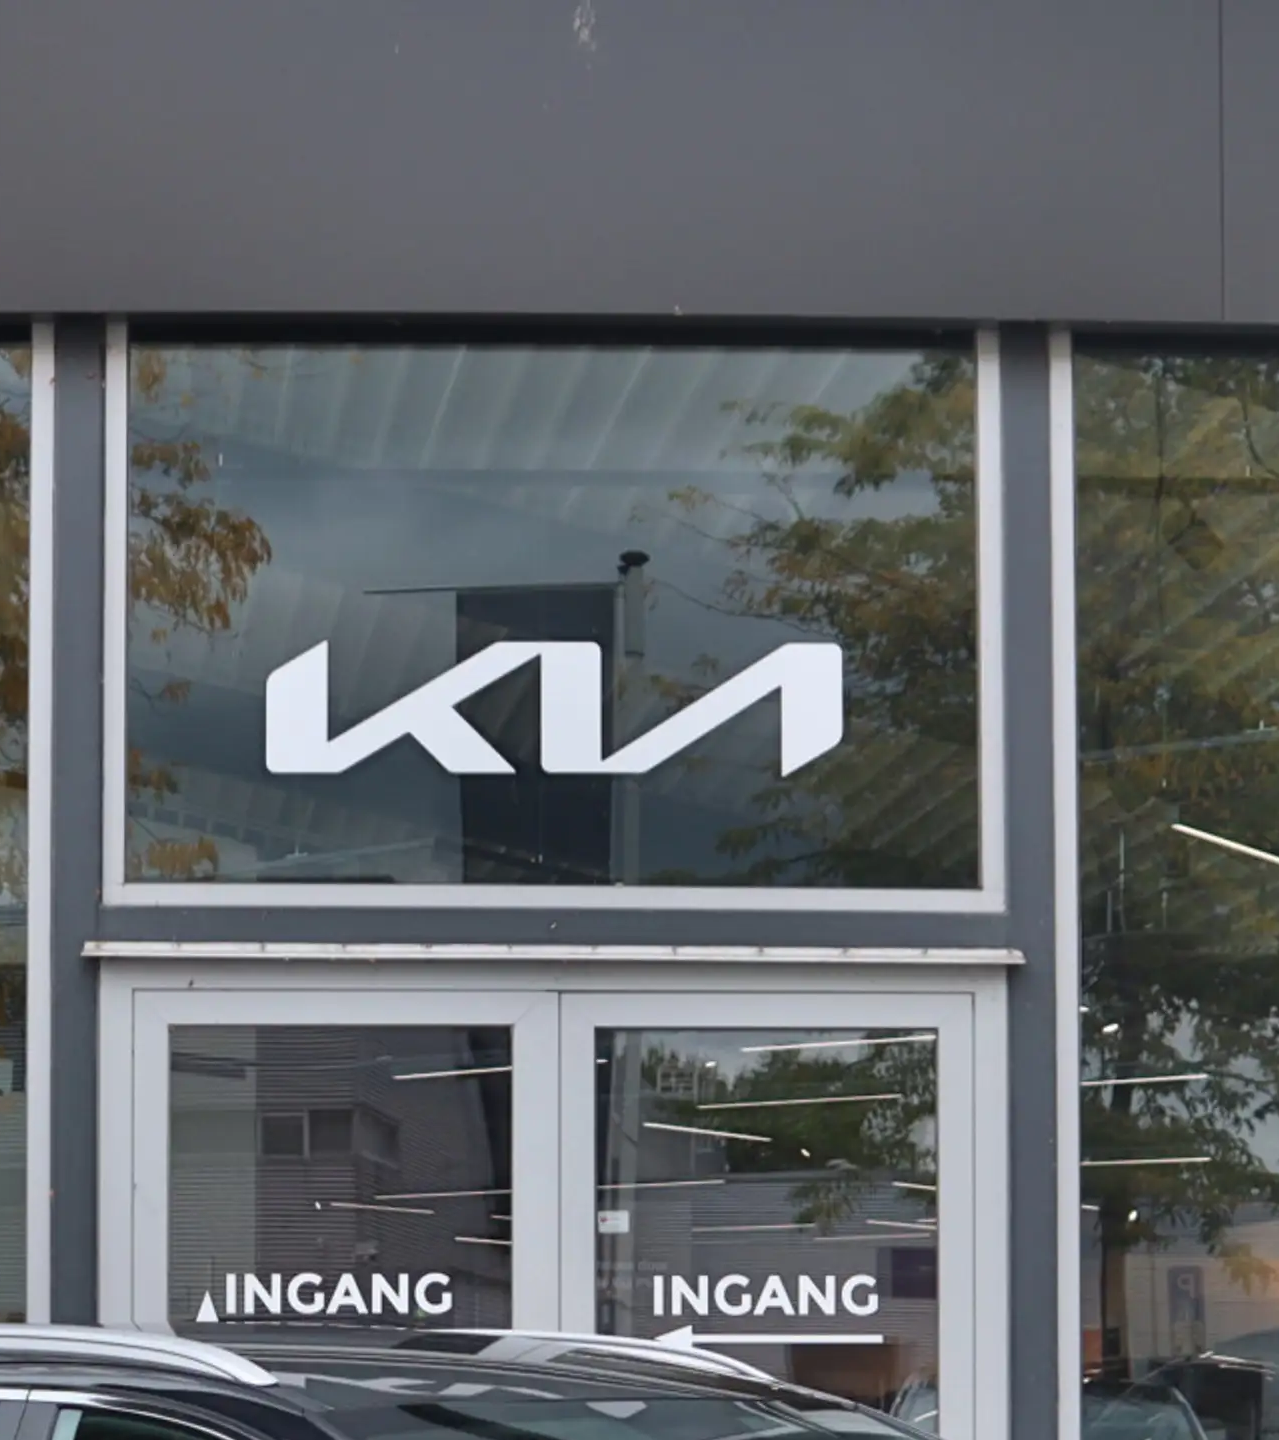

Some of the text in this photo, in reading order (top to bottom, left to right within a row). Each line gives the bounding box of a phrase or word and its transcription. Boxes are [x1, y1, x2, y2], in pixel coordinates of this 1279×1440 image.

[266, 639, 844, 777] KIA
[225, 1272, 454, 1317] INGANG
[653, 1274, 880, 1318] INGANG
